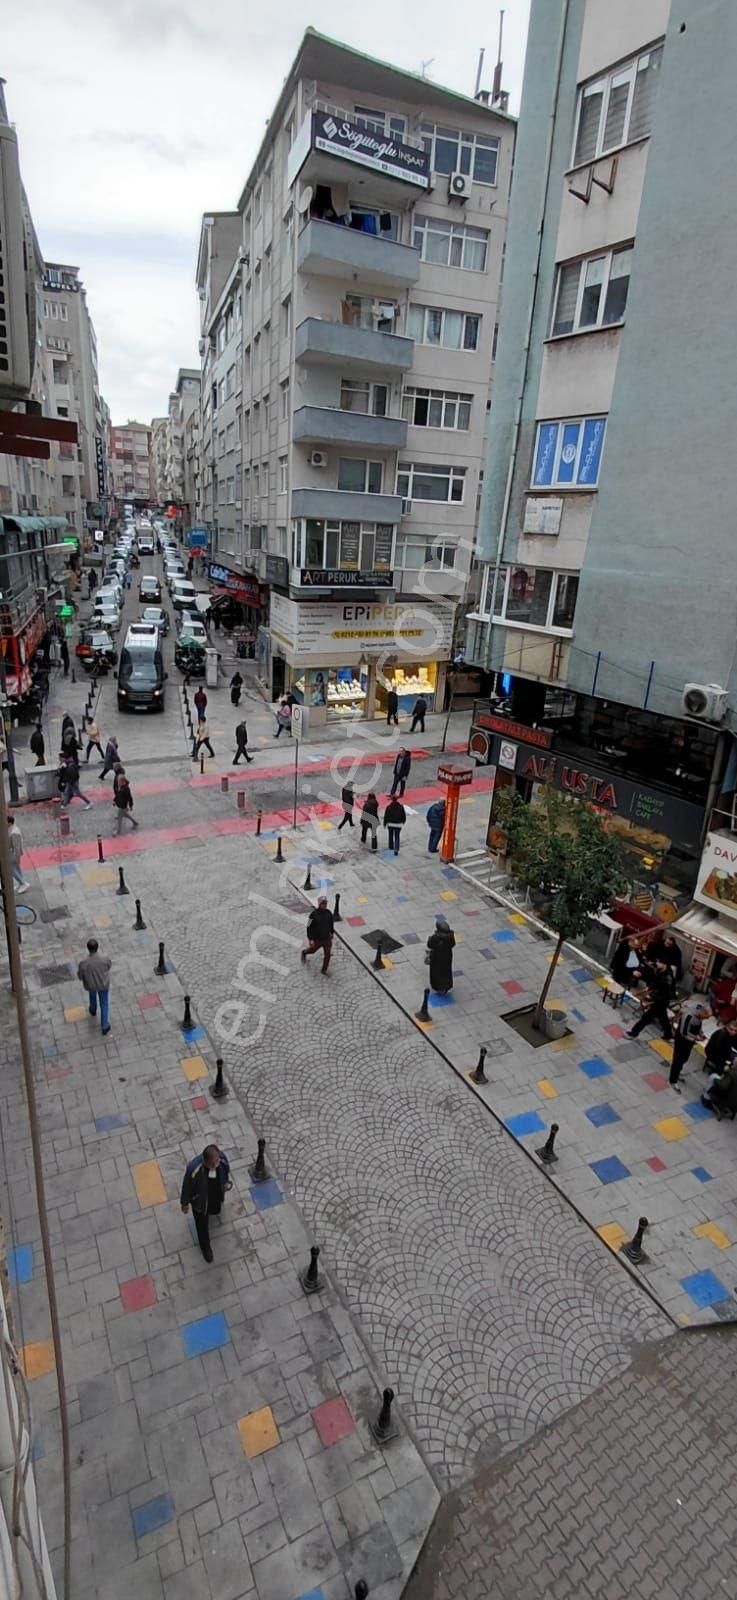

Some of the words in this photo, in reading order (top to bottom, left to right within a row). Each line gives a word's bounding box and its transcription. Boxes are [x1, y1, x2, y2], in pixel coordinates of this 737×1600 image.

[303, 570, 326, 585] ART
[327, 571, 358, 584] PERUK
[561, 766, 618, 808] USTA
